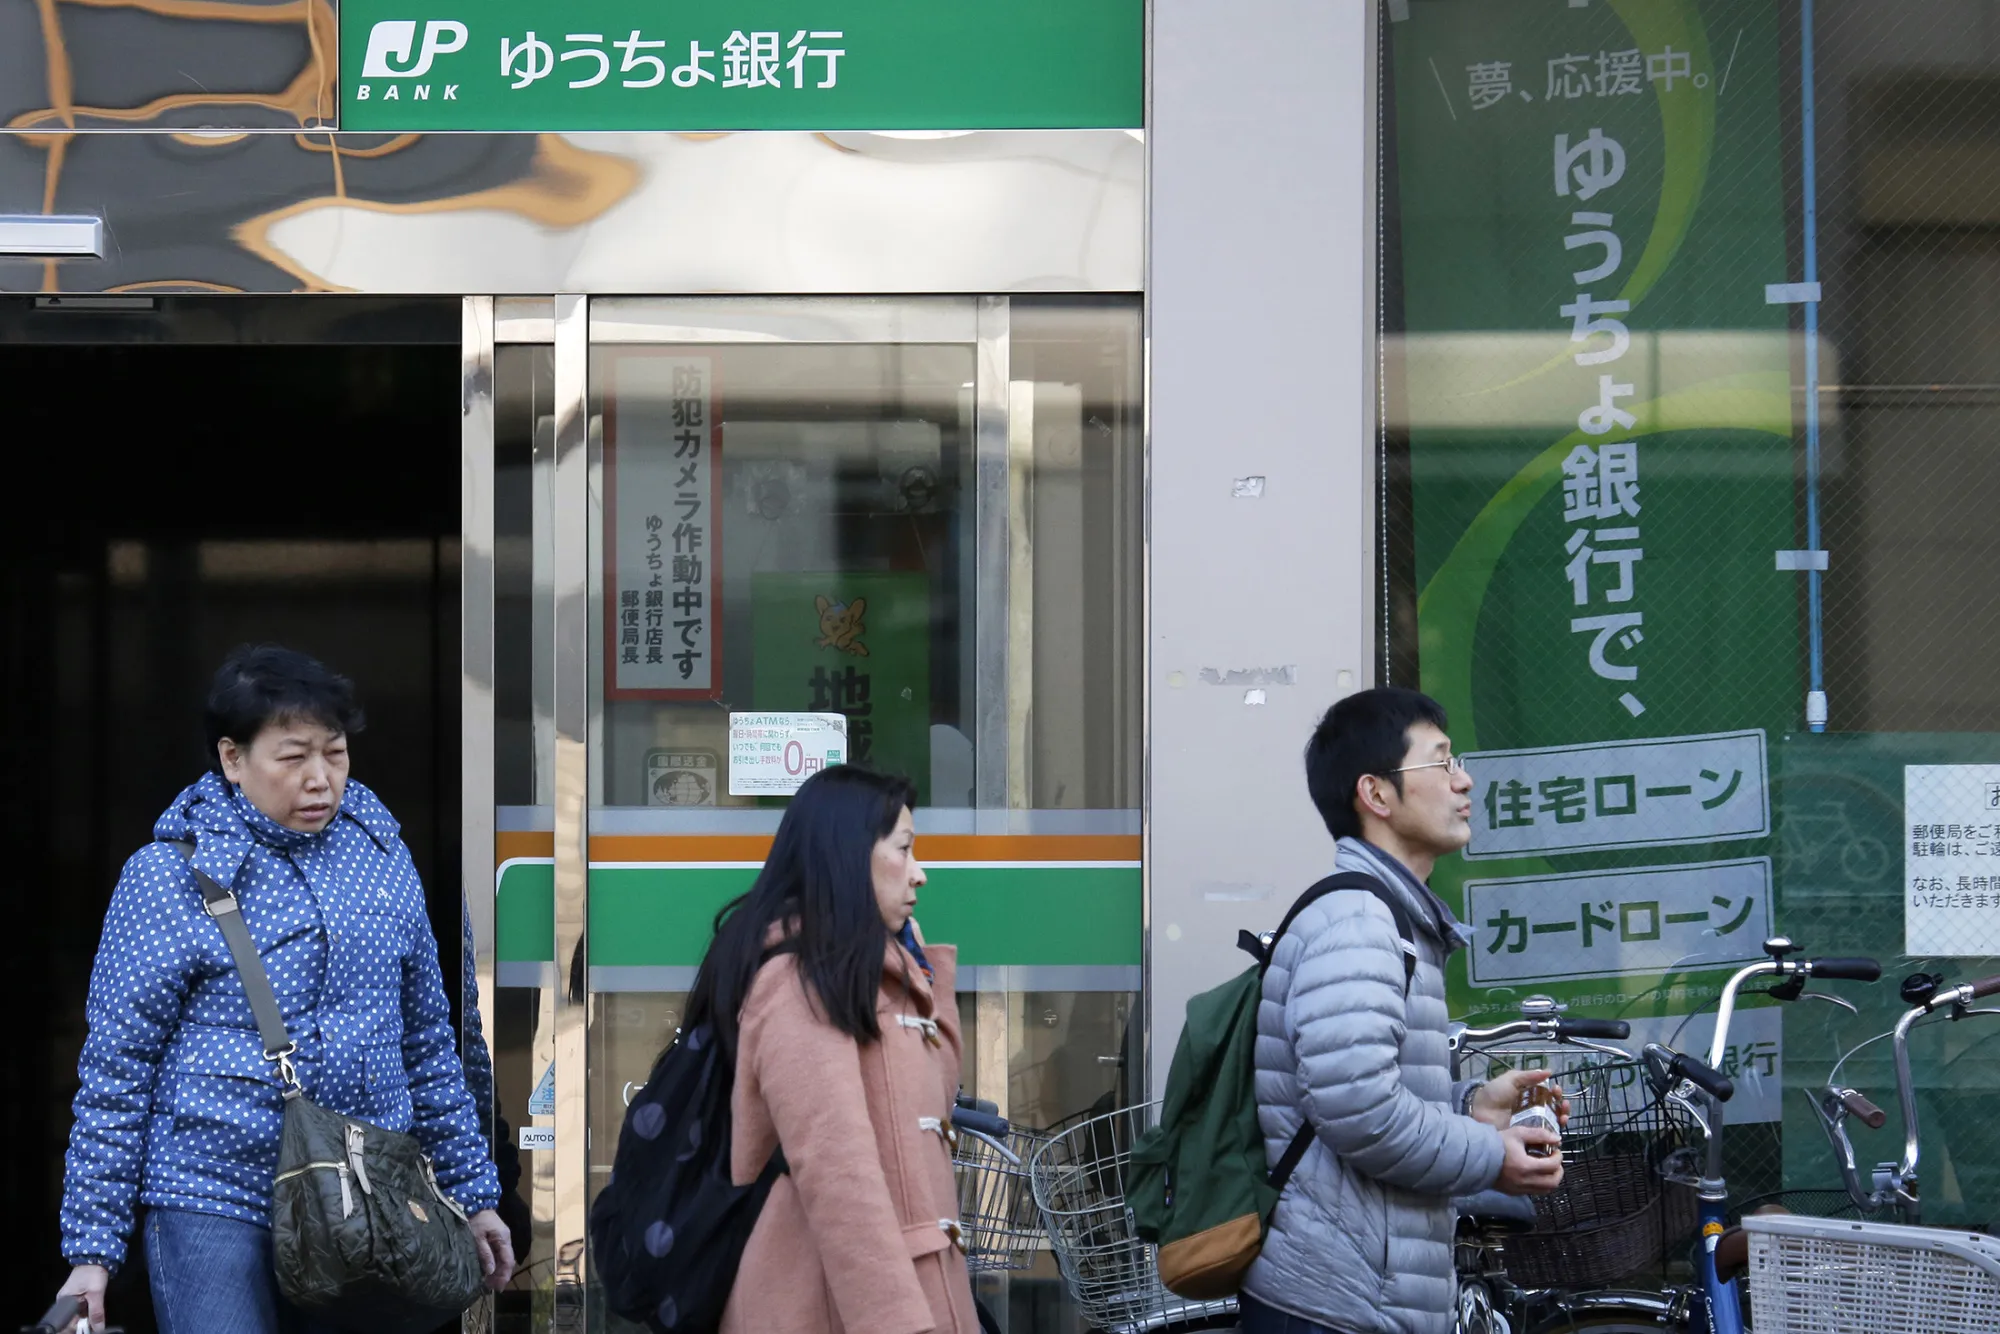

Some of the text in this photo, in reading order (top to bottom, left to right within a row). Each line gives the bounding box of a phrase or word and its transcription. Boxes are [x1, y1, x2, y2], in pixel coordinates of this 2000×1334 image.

[362, 20, 468, 78] JP
[500, 30, 846, 90] ゆうちょ銀行
[1465, 45, 1709, 110] 夢、応援中。
[357, 84, 460, 101] BANK
[1553, 127, 1647, 718] ゆうちょ銀行で、
[672, 365, 703, 680] 防犯カメラ作動中です
[645, 514, 663, 665] ゆうちょ銀行店長
[621, 590, 639, 665] 郵便局長
[1484, 767, 1743, 830] 住宅ローン
[1487, 894, 1754, 955] カードローン
[524, 1134, 547, 1142] AUTO
